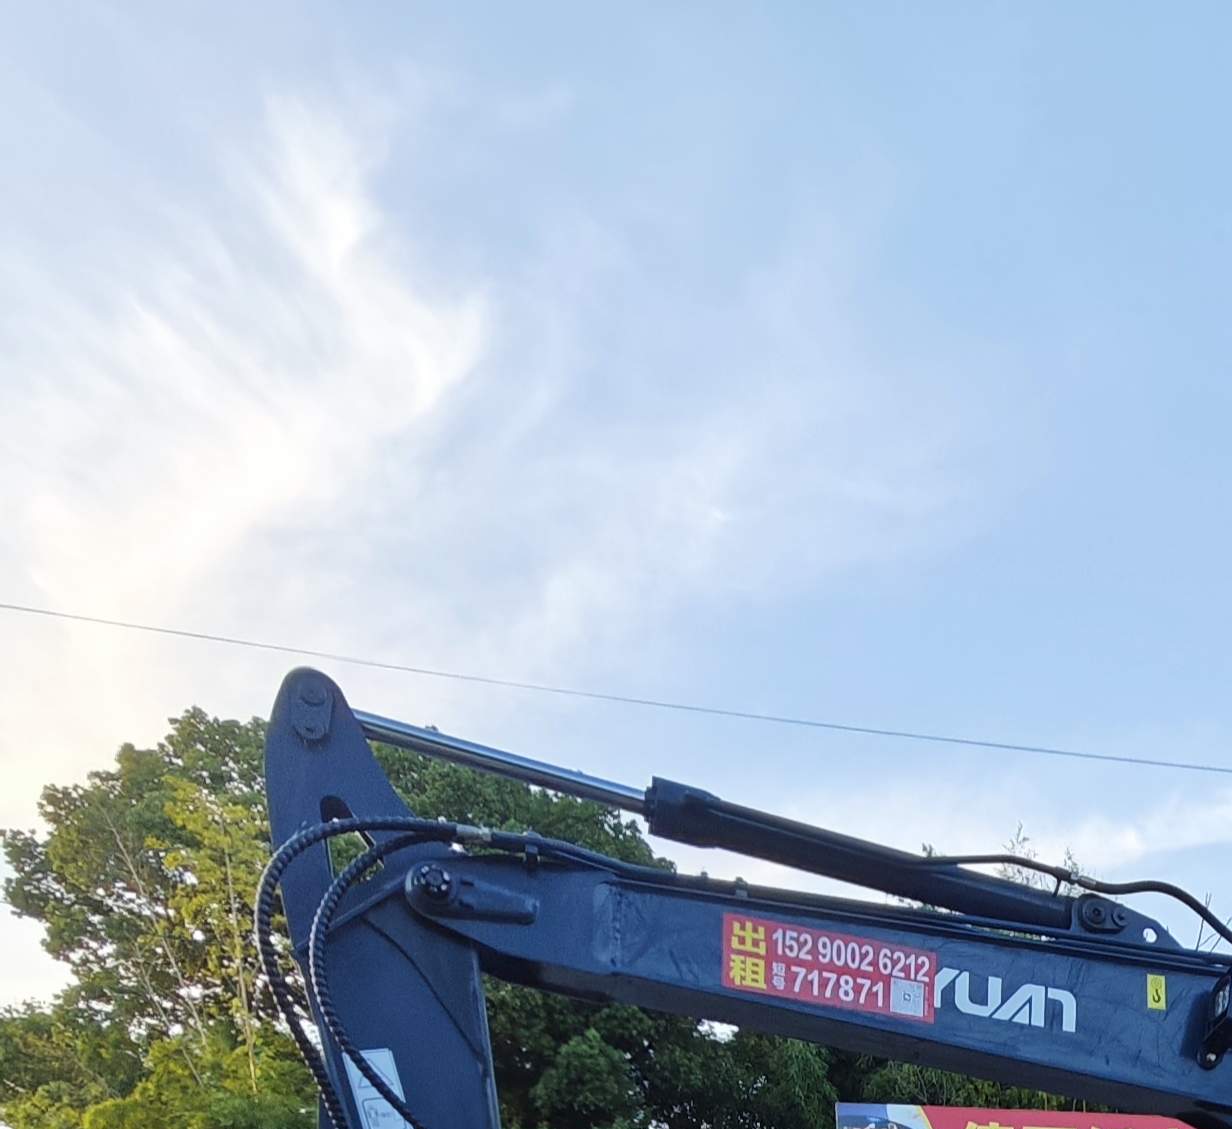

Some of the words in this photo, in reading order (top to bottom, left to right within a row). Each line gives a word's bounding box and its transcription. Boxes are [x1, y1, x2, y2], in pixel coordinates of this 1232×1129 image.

[729, 920, 768, 990] 出租
[771, 927, 813, 959] 152
[817, 936, 874, 973] 9002
[877, 948, 930, 982] 6212
[790, 965, 884, 1008] 717871
